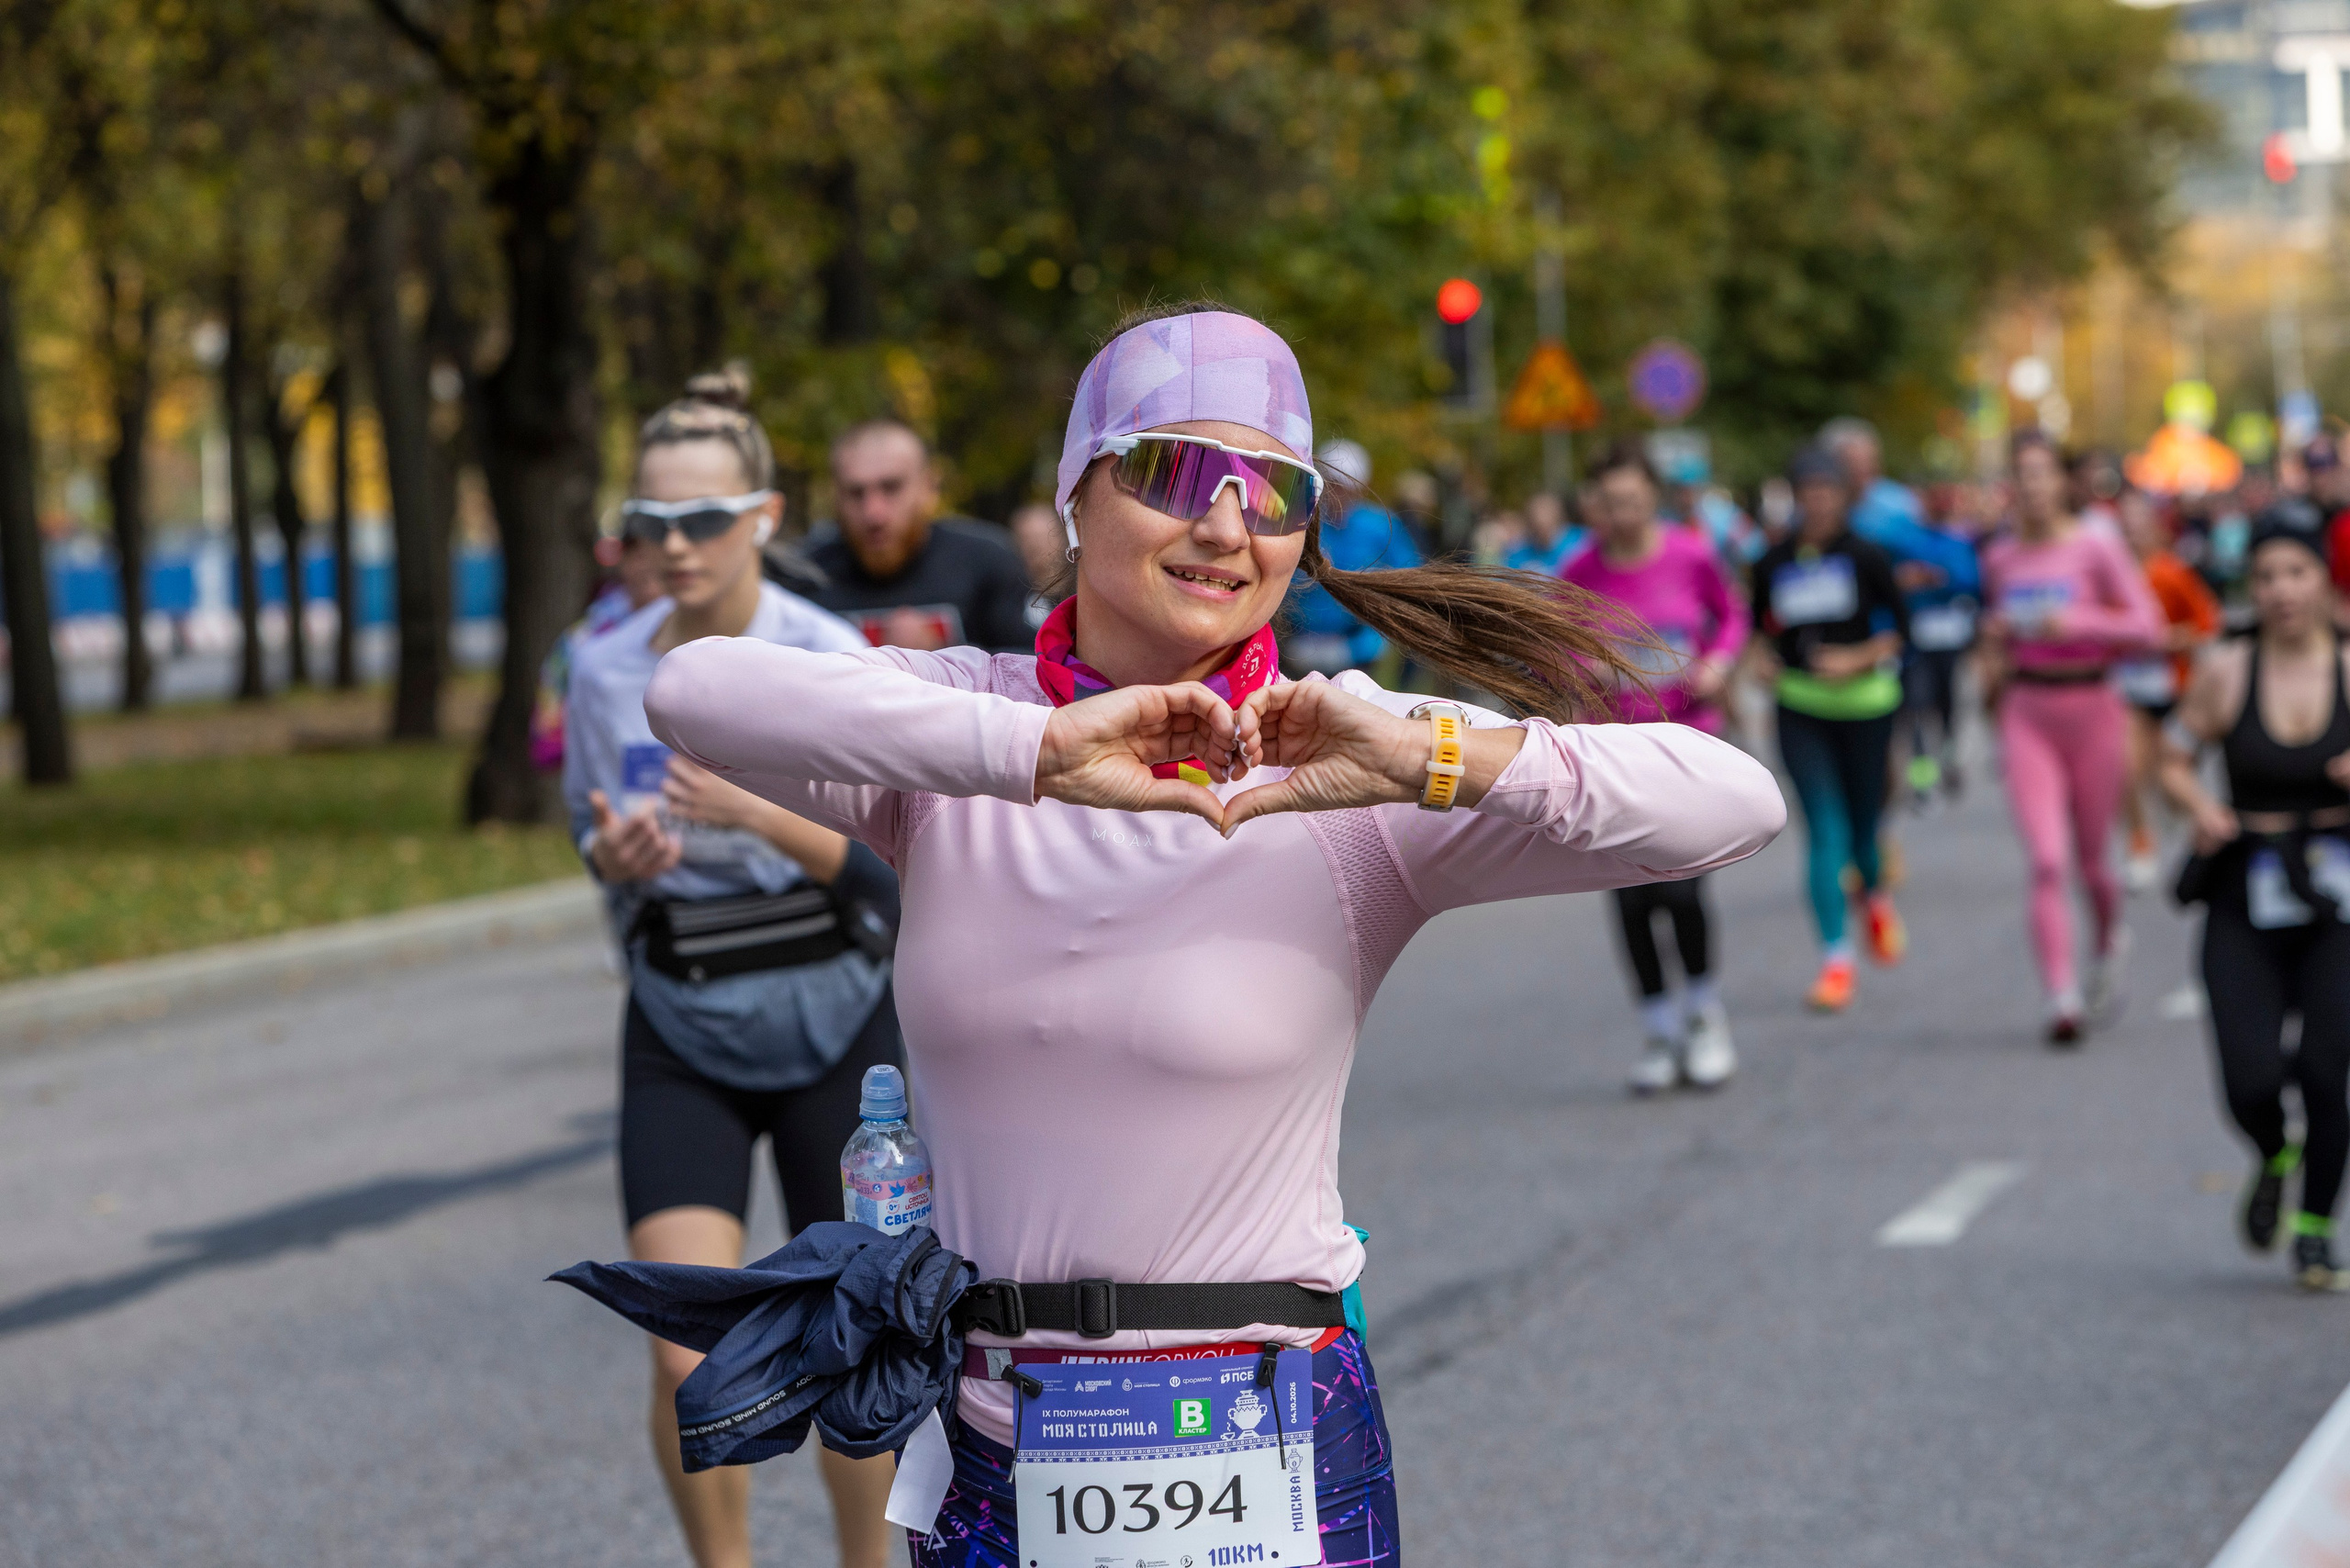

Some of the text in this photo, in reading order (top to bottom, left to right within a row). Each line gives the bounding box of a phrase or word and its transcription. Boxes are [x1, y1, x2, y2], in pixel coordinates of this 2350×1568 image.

[1091, 828, 1154, 847] MOAX
[796, 1374, 816, 1388] ODY
[1232, 1371, 1255, 1383] ПСБ
[757, 1390, 787, 1411] SOUND
[733, 1407, 757, 1422] MIND,
[1042, 1408, 1130, 1417] IX ПОЛУМАРАФОН
[699, 1418, 733, 1434] SOUND
[1043, 1421, 1158, 1439] МОЯ СТОЛИЦА
[1046, 1474, 1248, 1534] 10394
[1290, 1475, 1304, 1532] МОСКВА
[1208, 1542, 1264, 1567] 10КМ
